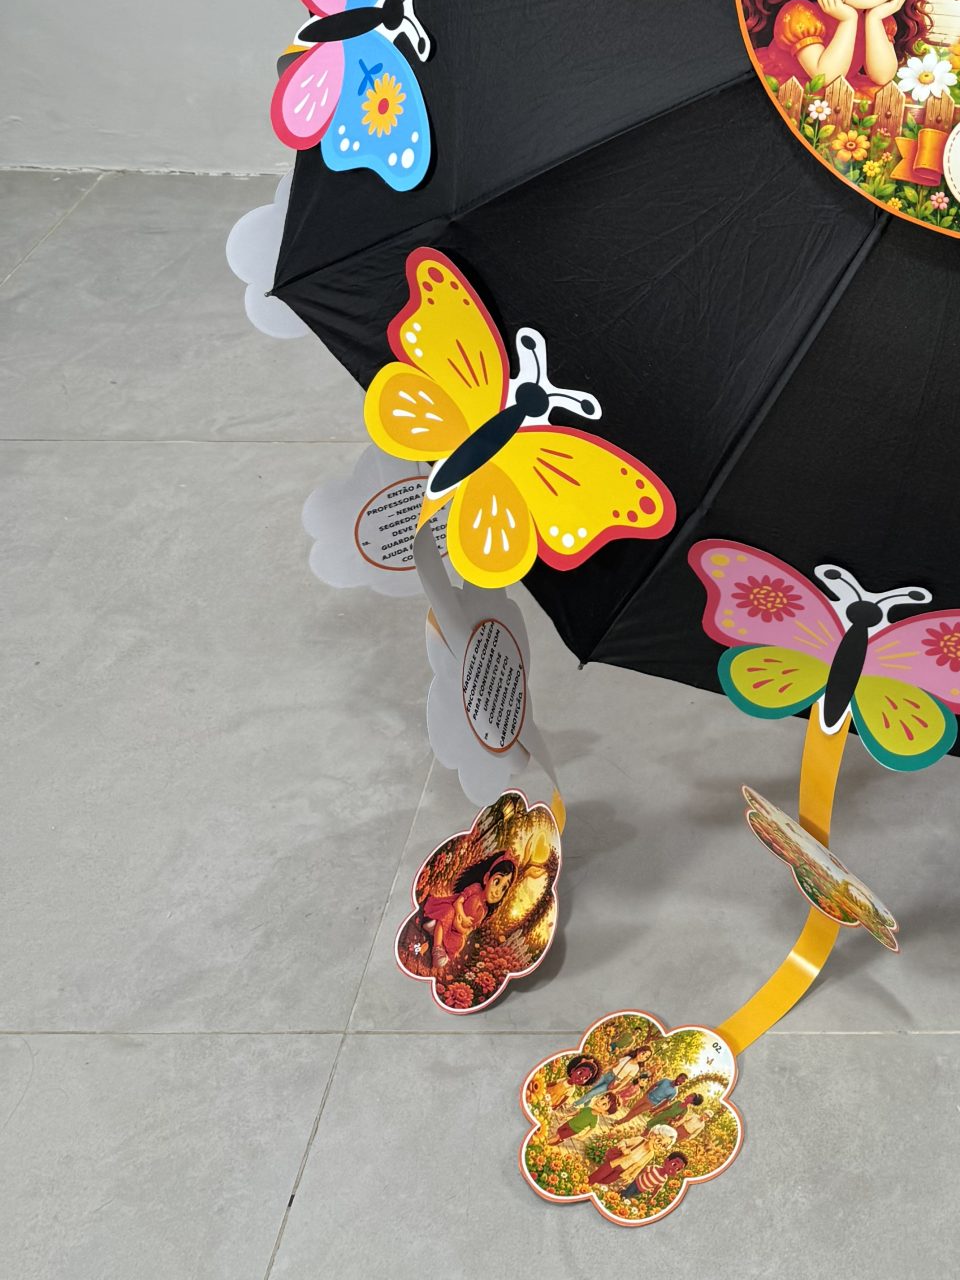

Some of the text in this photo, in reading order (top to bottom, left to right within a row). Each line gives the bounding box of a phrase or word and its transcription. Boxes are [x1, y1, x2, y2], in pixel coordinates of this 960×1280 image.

[366, 494, 421, 516] PROFESSORA
[387, 485, 415, 499] ENTÃO
[378, 515, 417, 532] SEGREDO
[392, 525, 414, 537] DEVE
[382, 547, 409, 561] AJUDA
[463, 654, 477, 694] NAQUELE
[466, 621, 495, 712] ENCONTROU CORAGEM
[473, 629, 500, 720] PARA CONVERSAR COM
[483, 651, 502, 712] UM ADULTO DE
[488, 677, 503, 724] CONFIANÇA
[495, 667, 514, 729] ACOLHIDA COM
[508, 670, 521, 707] CUIDADO
